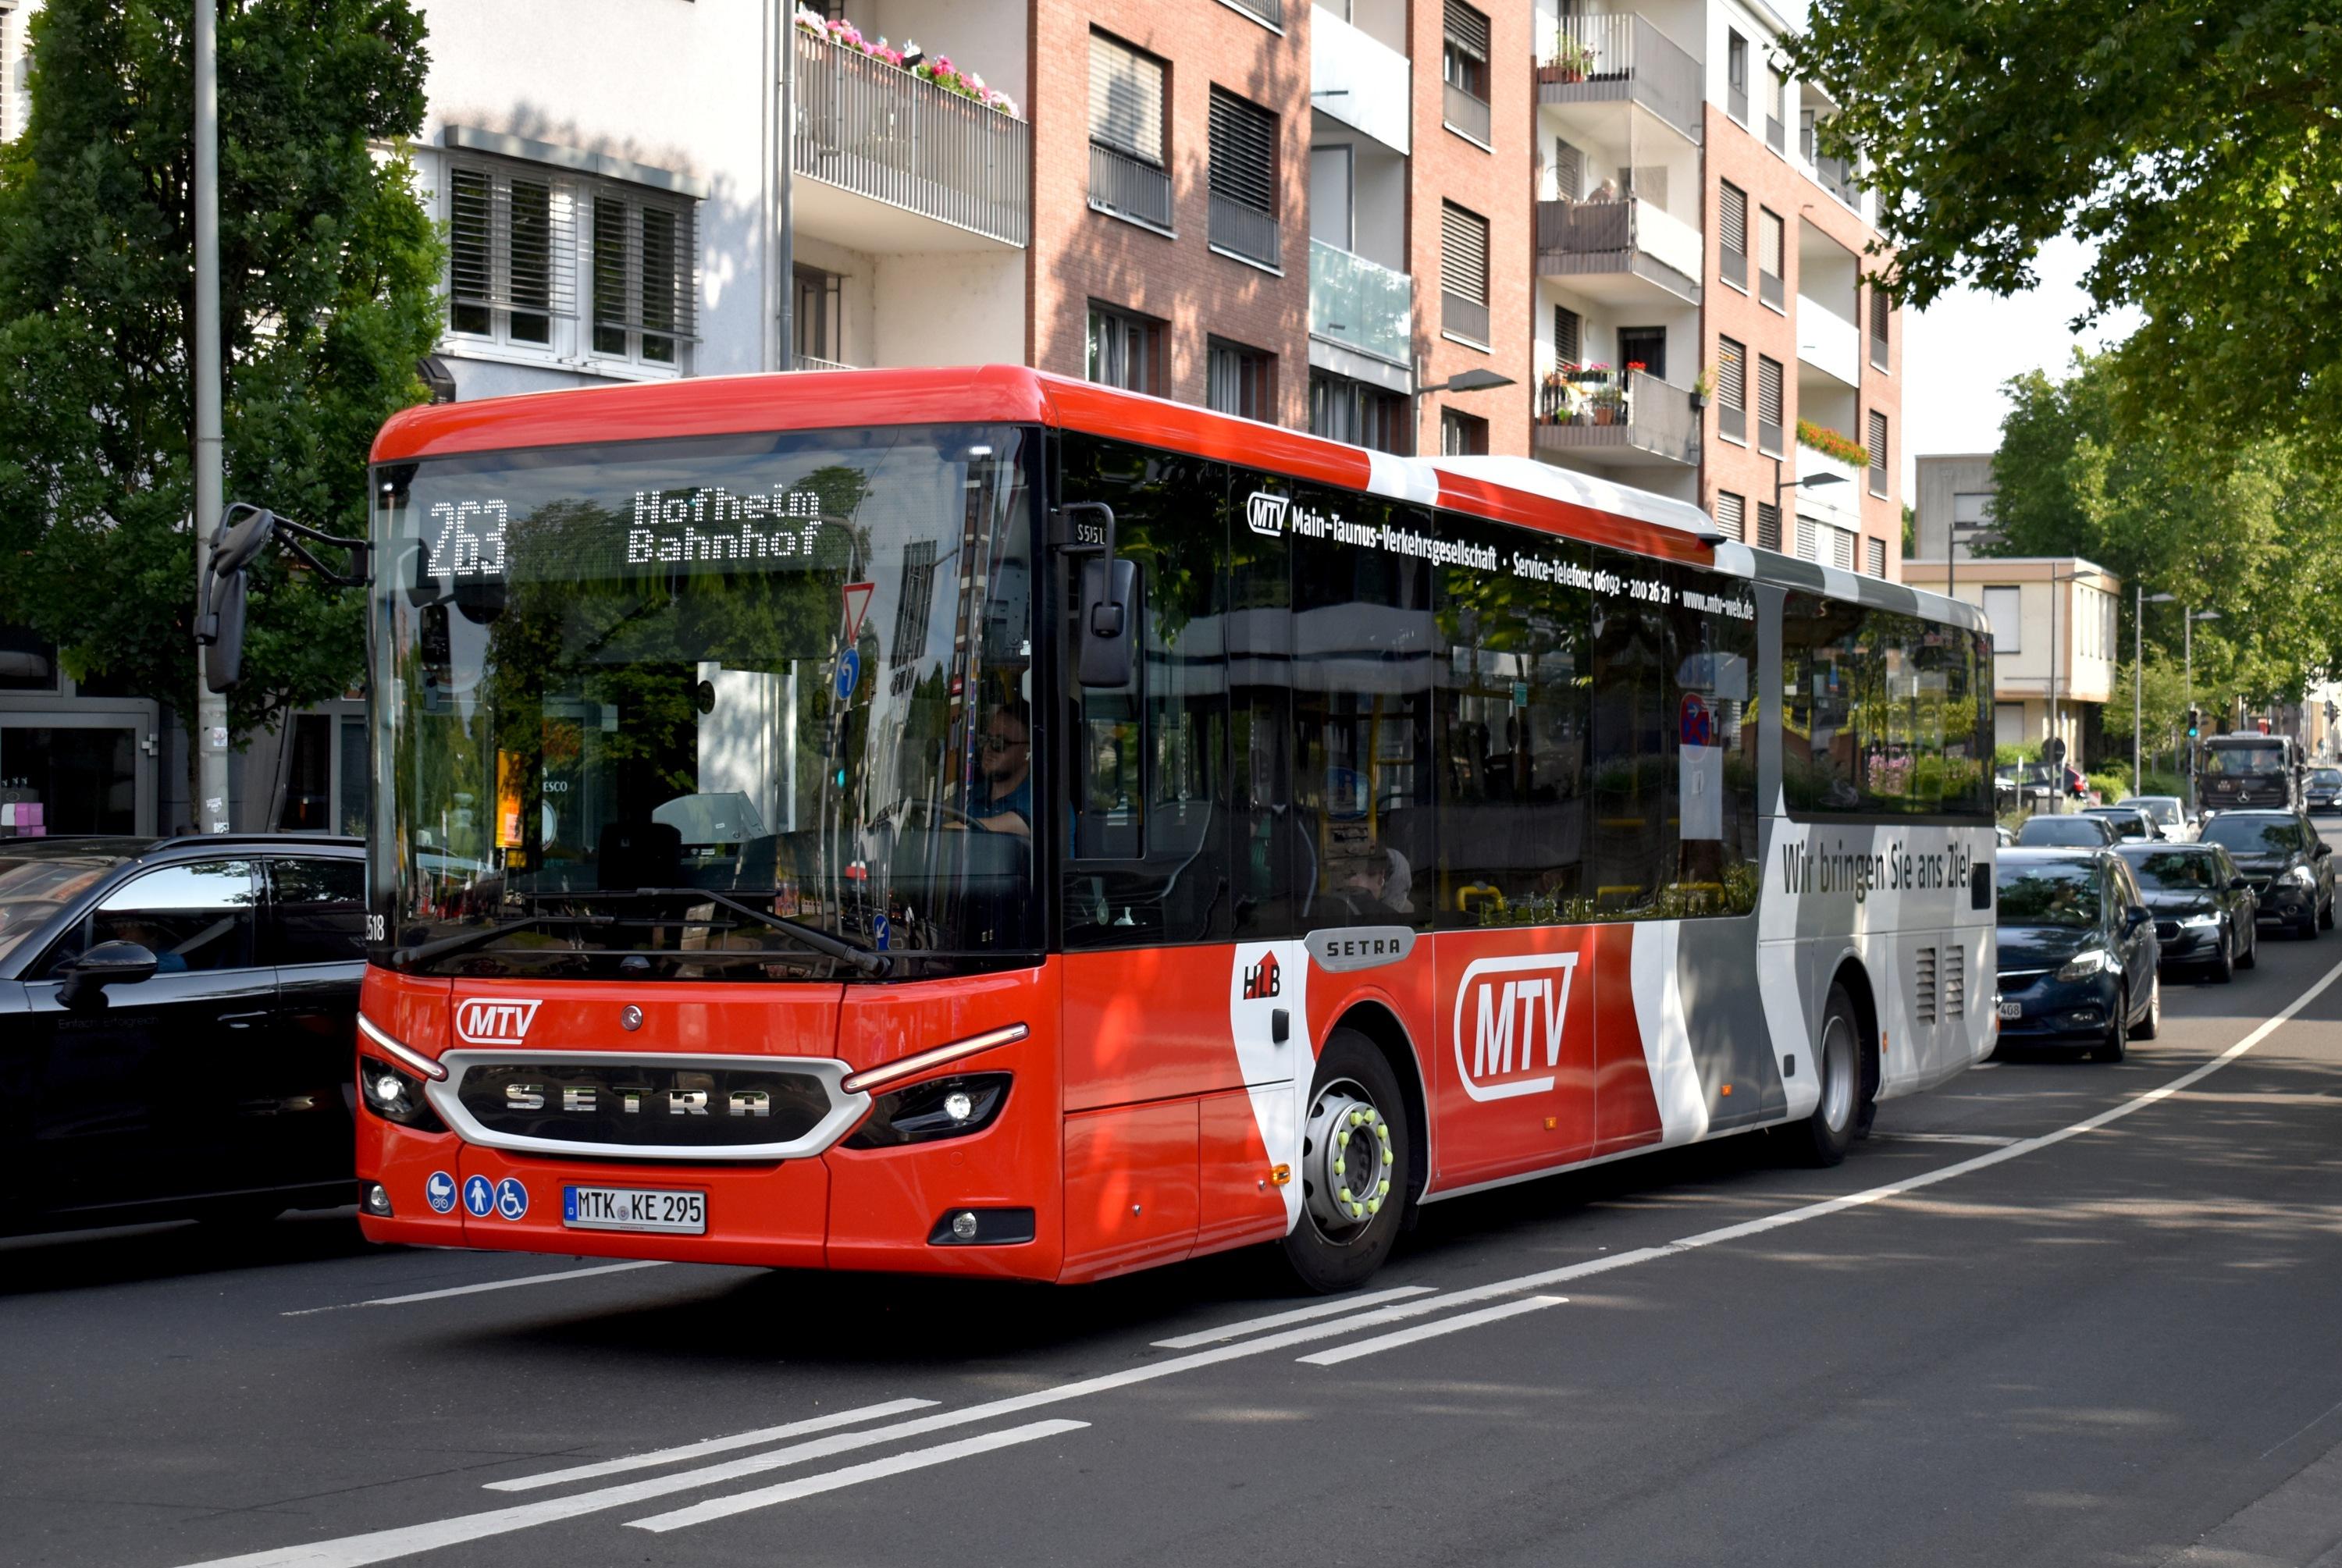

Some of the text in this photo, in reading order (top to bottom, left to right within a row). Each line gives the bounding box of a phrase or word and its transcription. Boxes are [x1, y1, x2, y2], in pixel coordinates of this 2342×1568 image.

[634, 483, 820, 525] Hofheim
[1251, 498, 1287, 532] MTV
[426, 500, 509, 578] 263
[628, 521, 822, 564] Bahnhof
[1291, 505, 1497, 571] Main-Taunus-Verkehrsgesellschaft
[1512, 551, 1592, 590] Service-Telefon:
[1593, 569, 1620, 597] 06192
[1630, 579, 1647, 600] 200
[1648, 580, 1660, 602] 26
[1661, 585, 1671, 604] 21
[1682, 590, 1753, 620] www.mtv-web.de
[1782, 840, 1971, 904] Wir bringen Sie ans Ziel
[1326, 938, 1401, 957] SETRA
[1243, 964, 1281, 1001] HLB
[468, 1003, 541, 1038] MTV
[1472, 963, 1575, 1078] MTV
[2001, 1004, 2020, 1016] 408
[506, 1084, 771, 1117] SETRA
[578, 1191, 701, 1223] MTK KE 295
